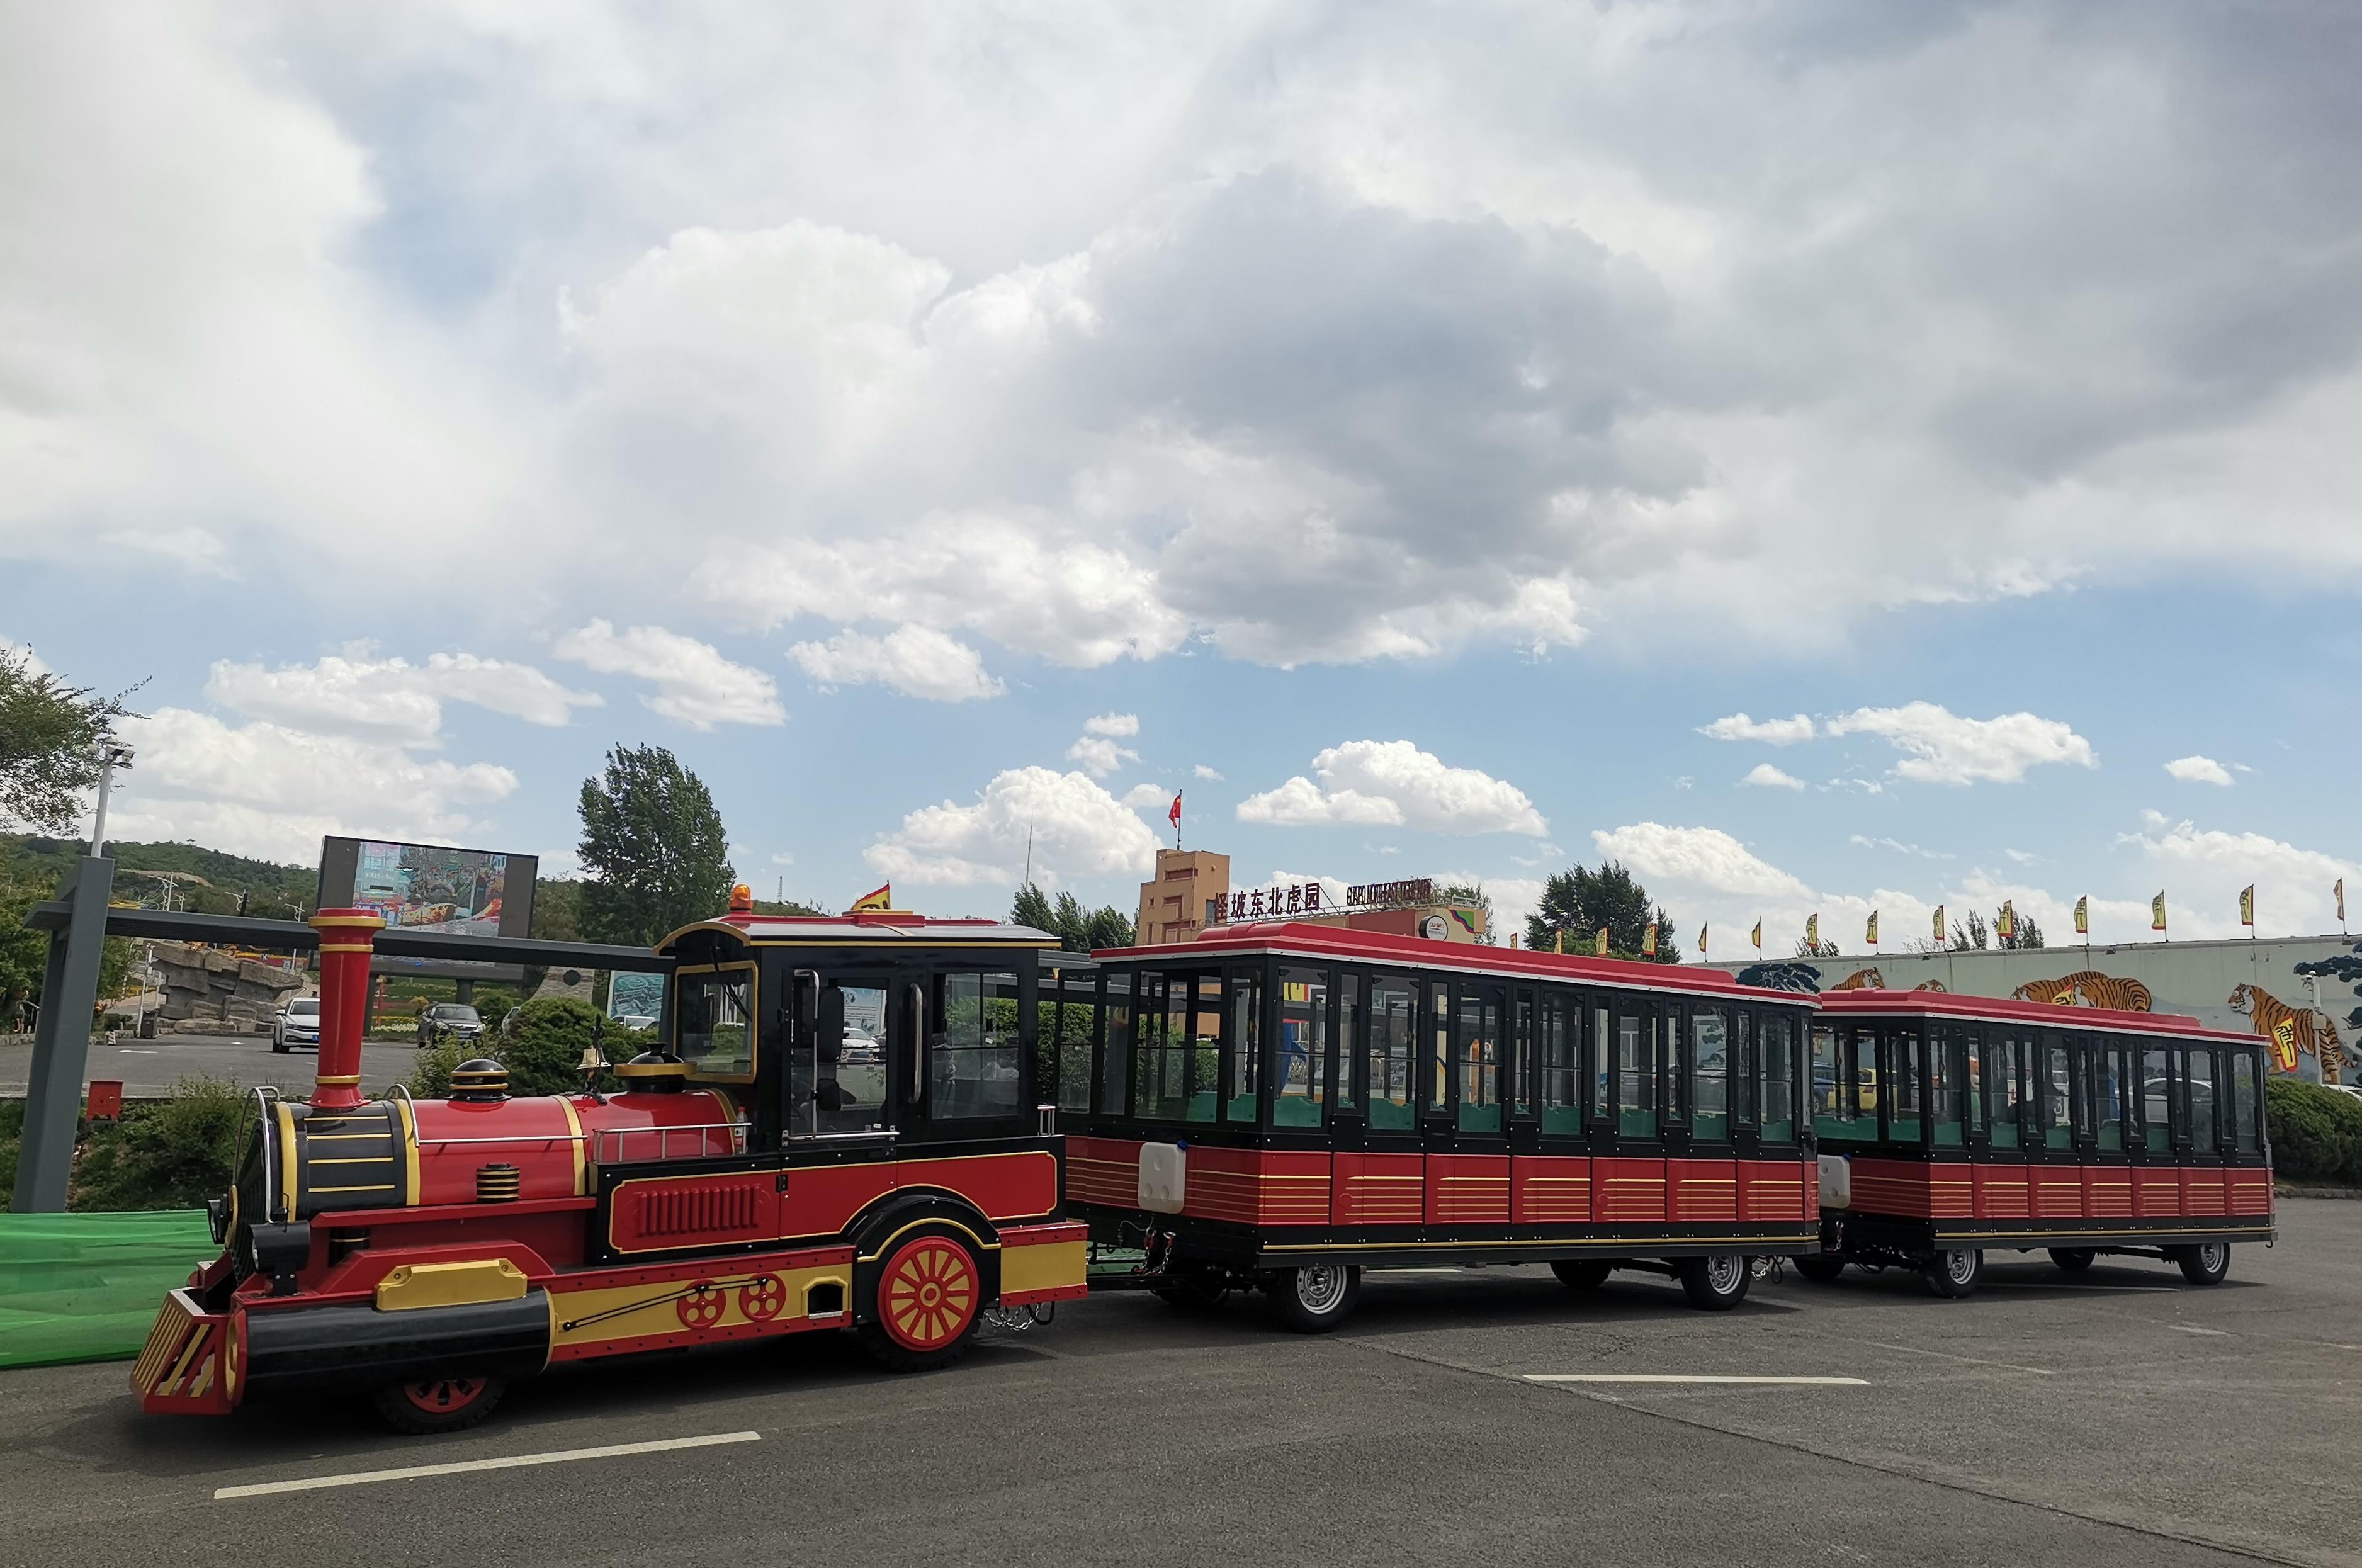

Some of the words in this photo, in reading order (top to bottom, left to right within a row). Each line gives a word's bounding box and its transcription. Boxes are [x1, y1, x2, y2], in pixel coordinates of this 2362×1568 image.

[1214, 883, 1319, 920] 怪坡东北虎园
